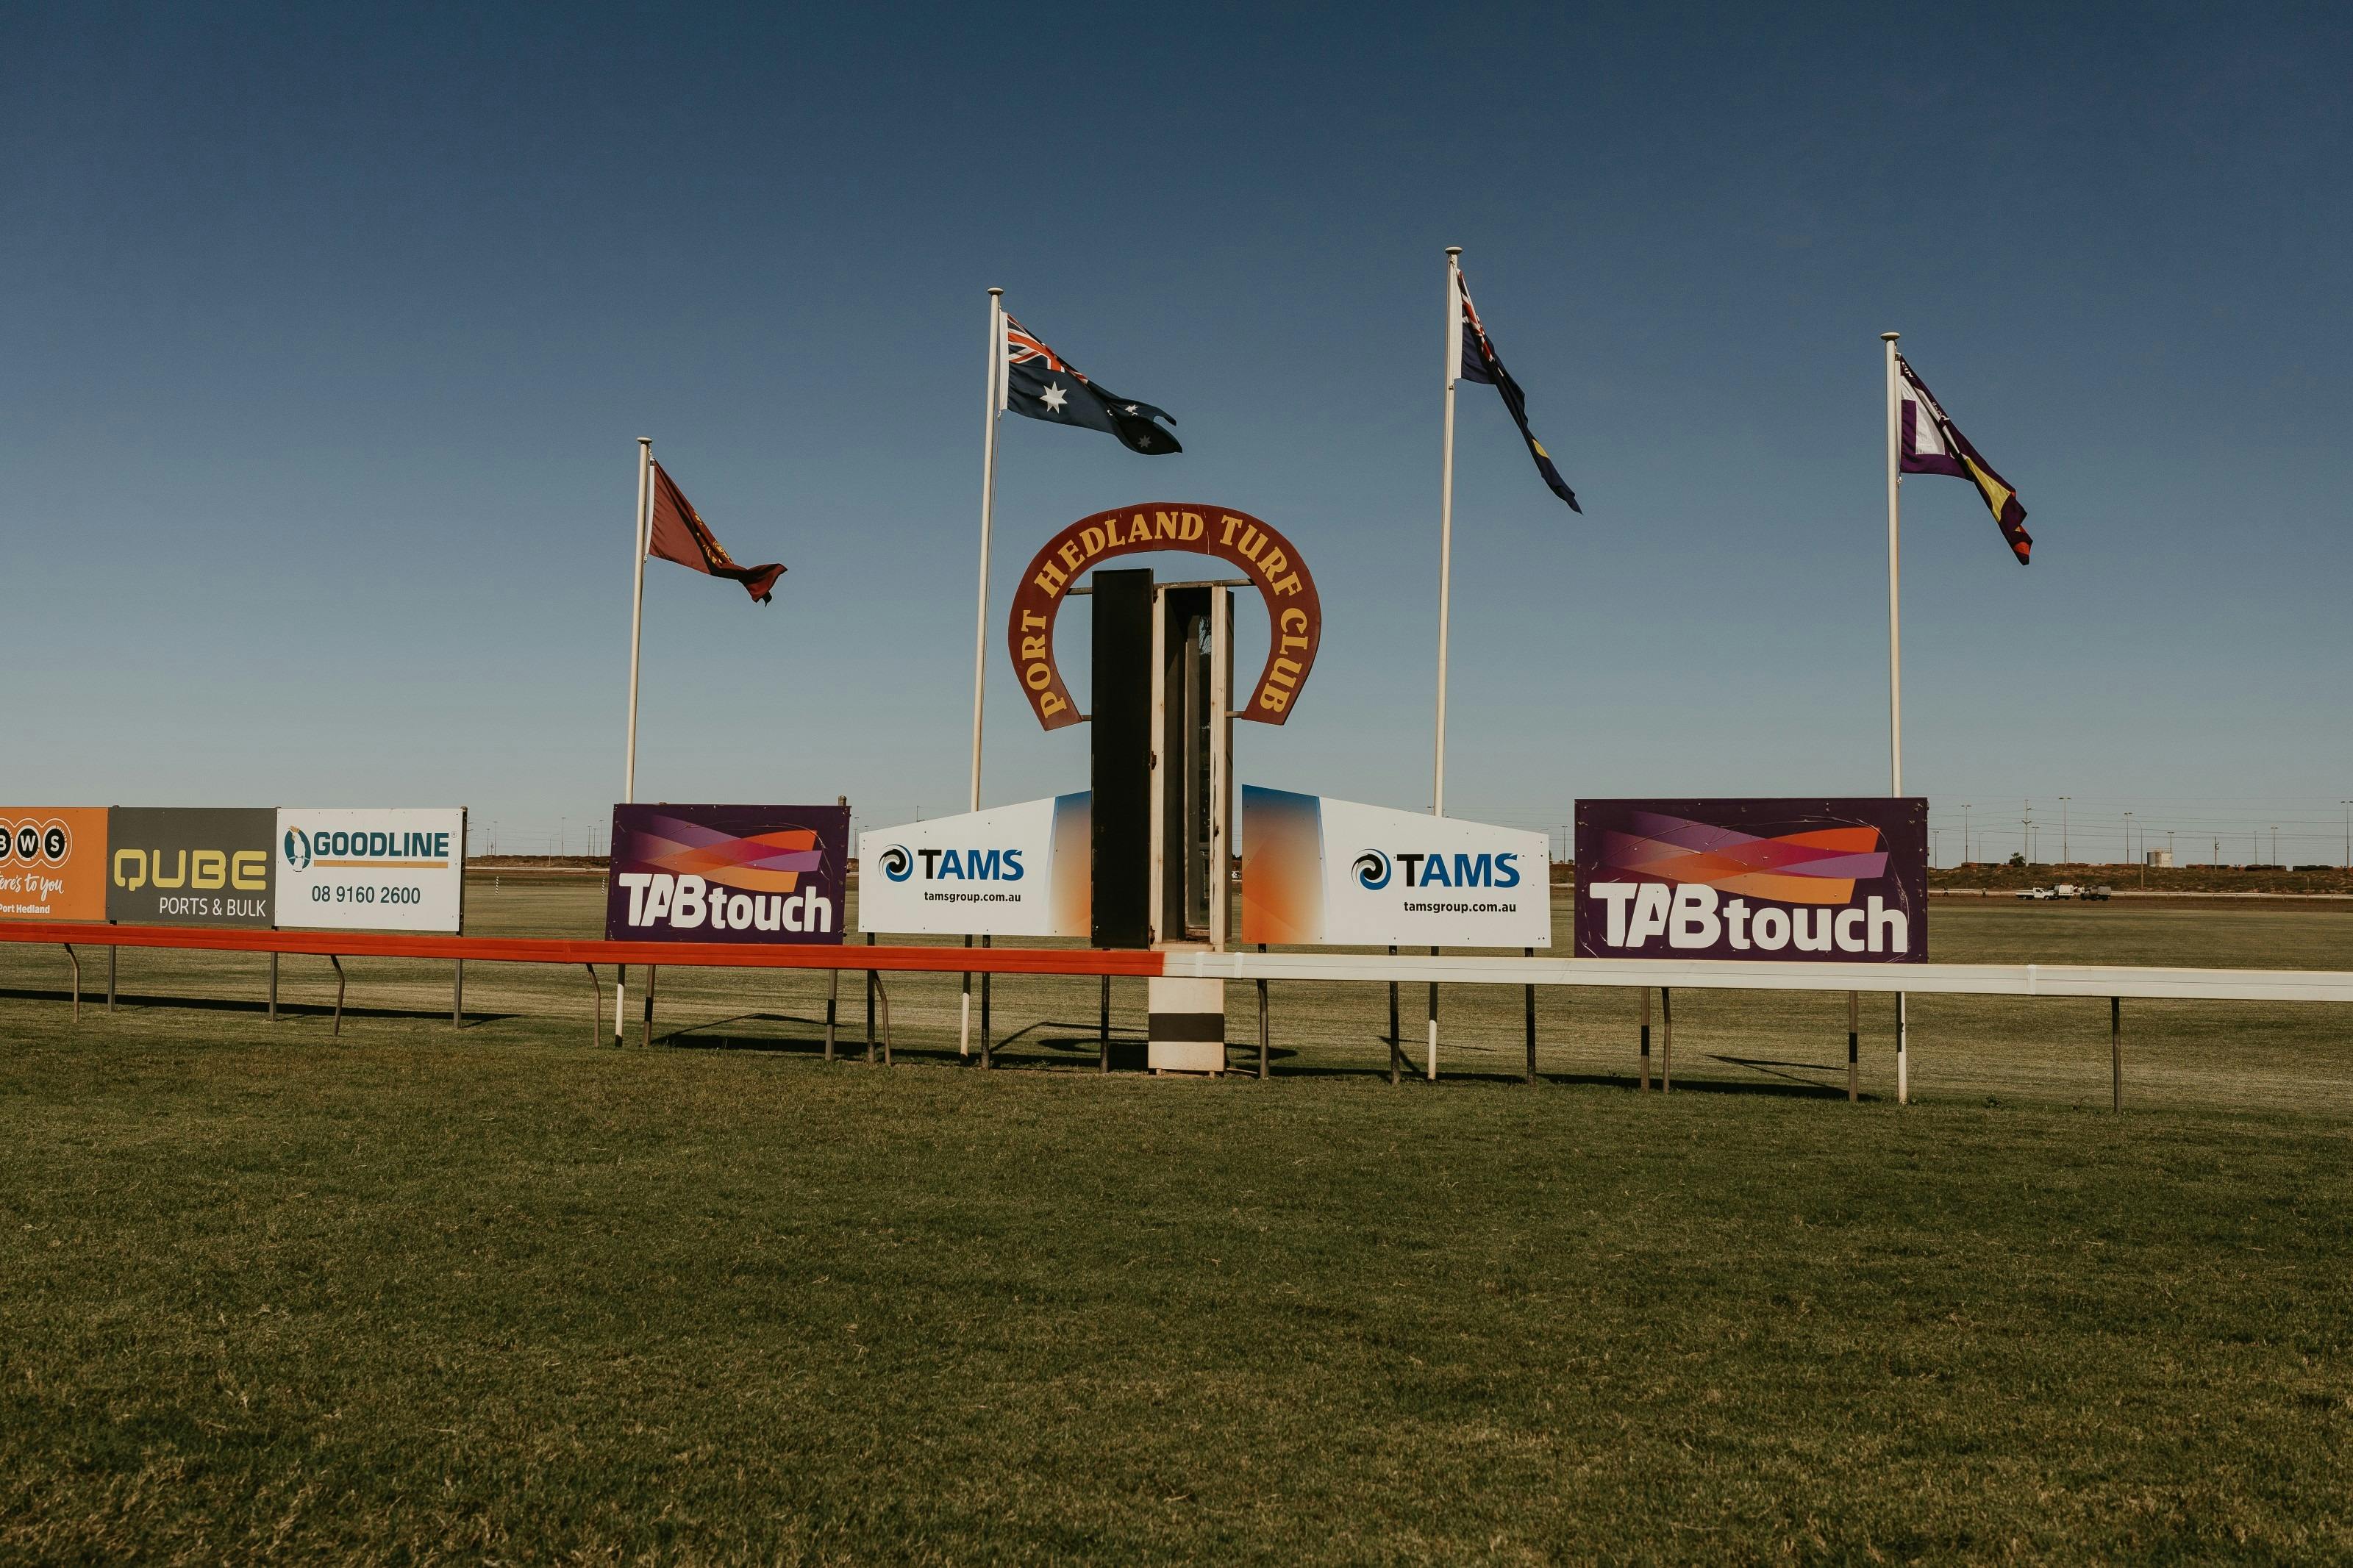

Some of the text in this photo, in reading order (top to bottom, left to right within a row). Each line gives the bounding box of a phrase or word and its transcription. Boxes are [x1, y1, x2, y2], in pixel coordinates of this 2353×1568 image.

[1021, 512, 1308, 718] PORT HEDLAND TURF CLUB
[313, 831, 449, 857] GOODLINE
[114, 848, 267, 891] QUBE
[918, 849, 1024, 881] TAMS
[1397, 853, 1521, 889] TAMS
[0, 871, 65, 902] ere's to you
[312, 885, 421, 904] 08 9160 2600
[924, 891, 1021, 903] tamsgroup.com.au
[16, 904, 51, 914] Hedland
[160, 897, 266, 917] PORTS & BULK
[618, 873, 832, 933] TABtouch
[1404, 901, 1516, 914] tamsgroup.com.au
[1589, 882, 1909, 953] TABtouch
